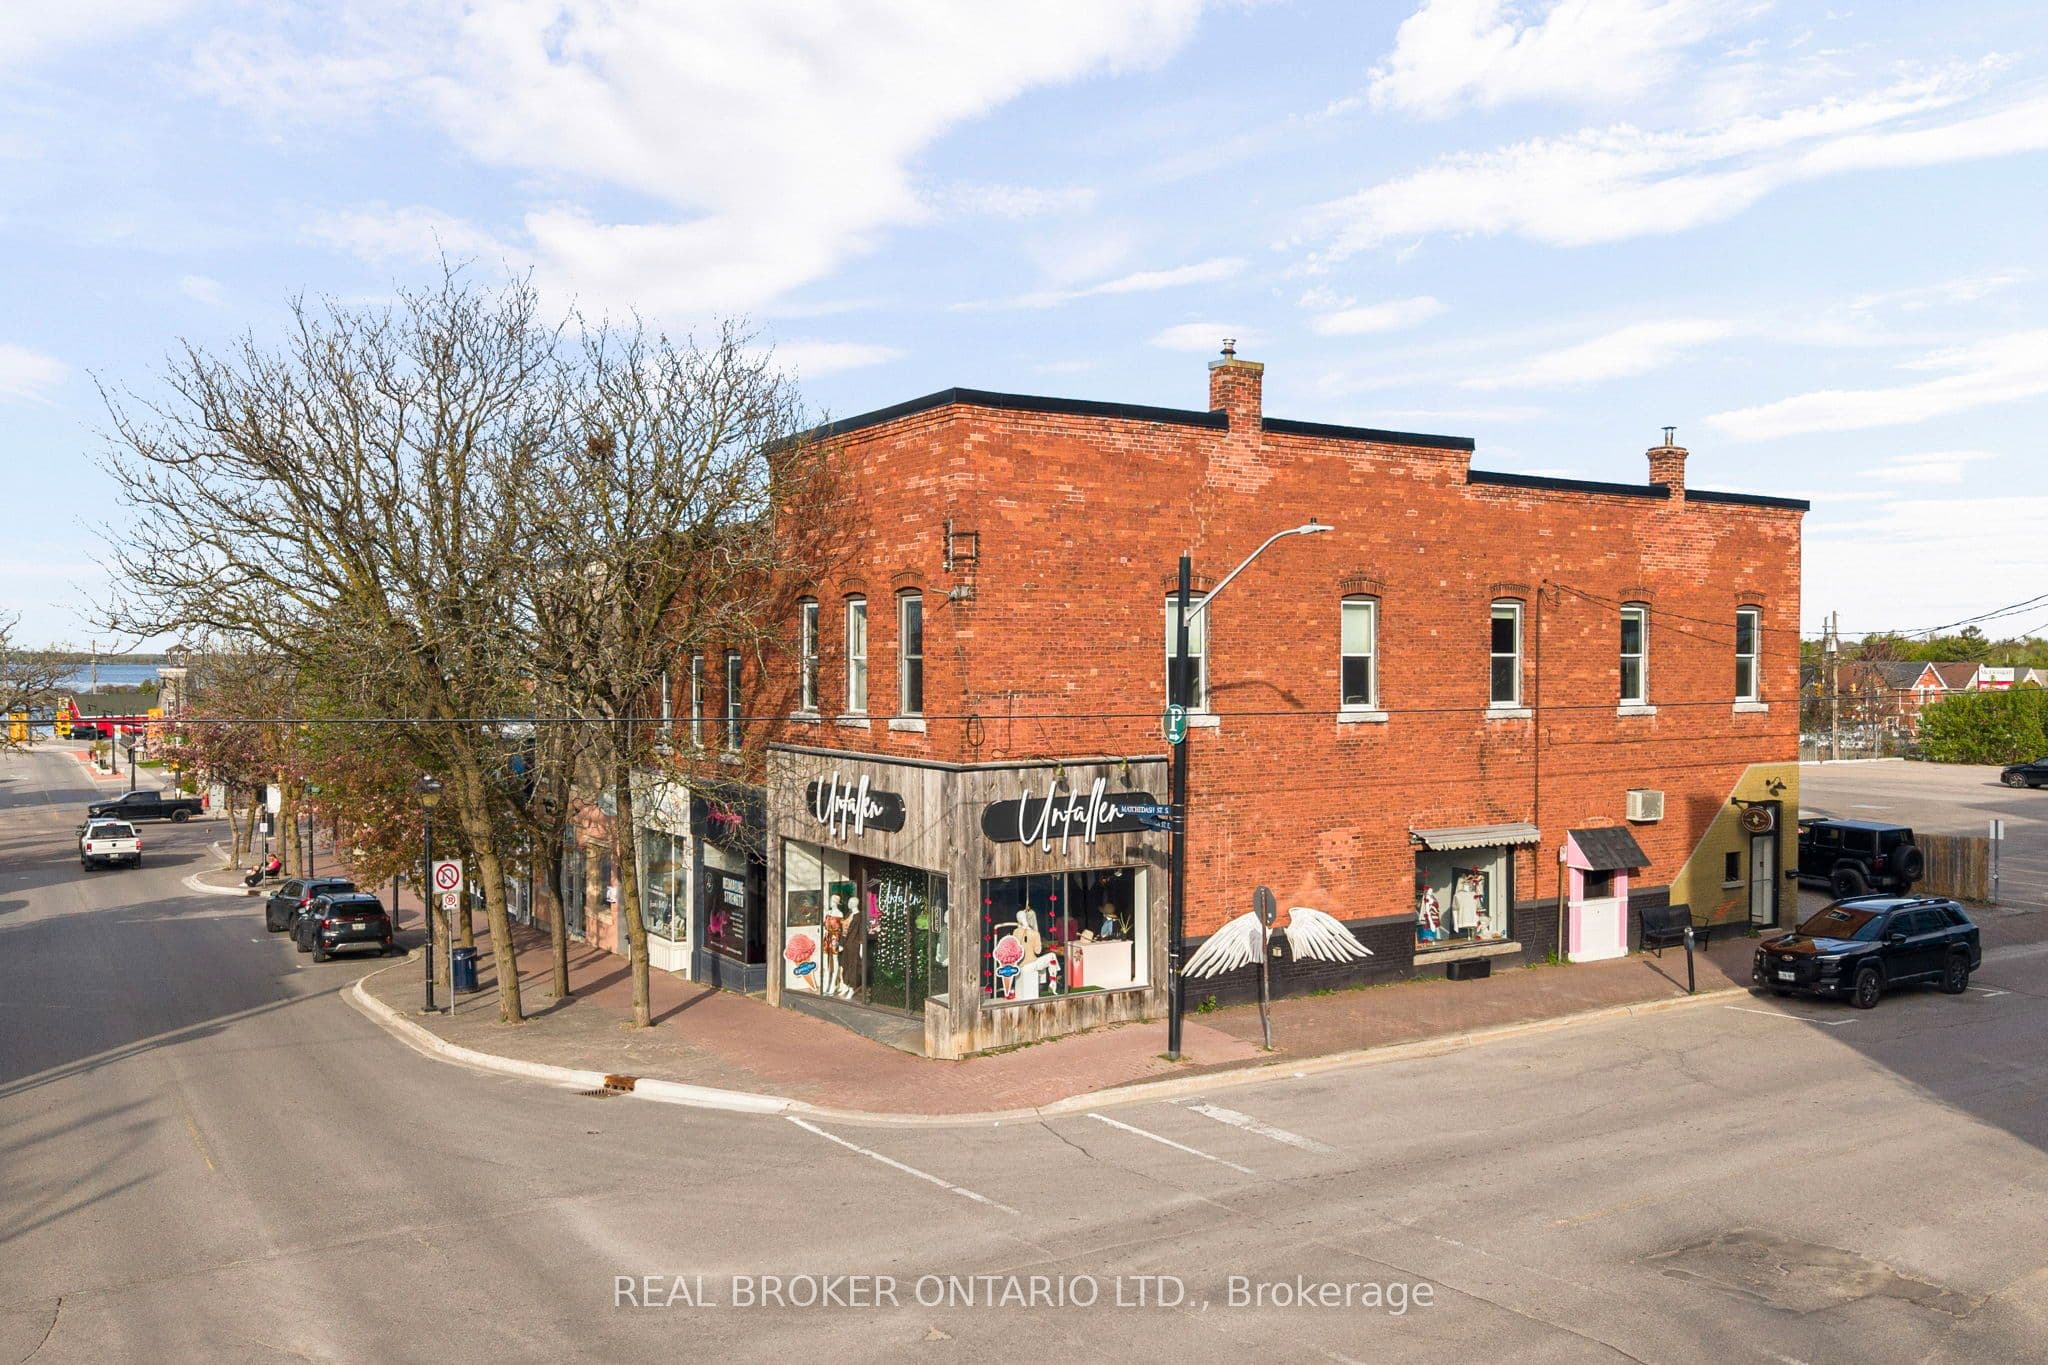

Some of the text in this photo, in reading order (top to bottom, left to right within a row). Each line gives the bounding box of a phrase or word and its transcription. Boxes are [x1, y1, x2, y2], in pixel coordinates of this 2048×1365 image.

[1170, 708, 1182, 731] P
[816, 770, 884, 840] Unfallen
[1018, 777, 1125, 855] Unfallen
